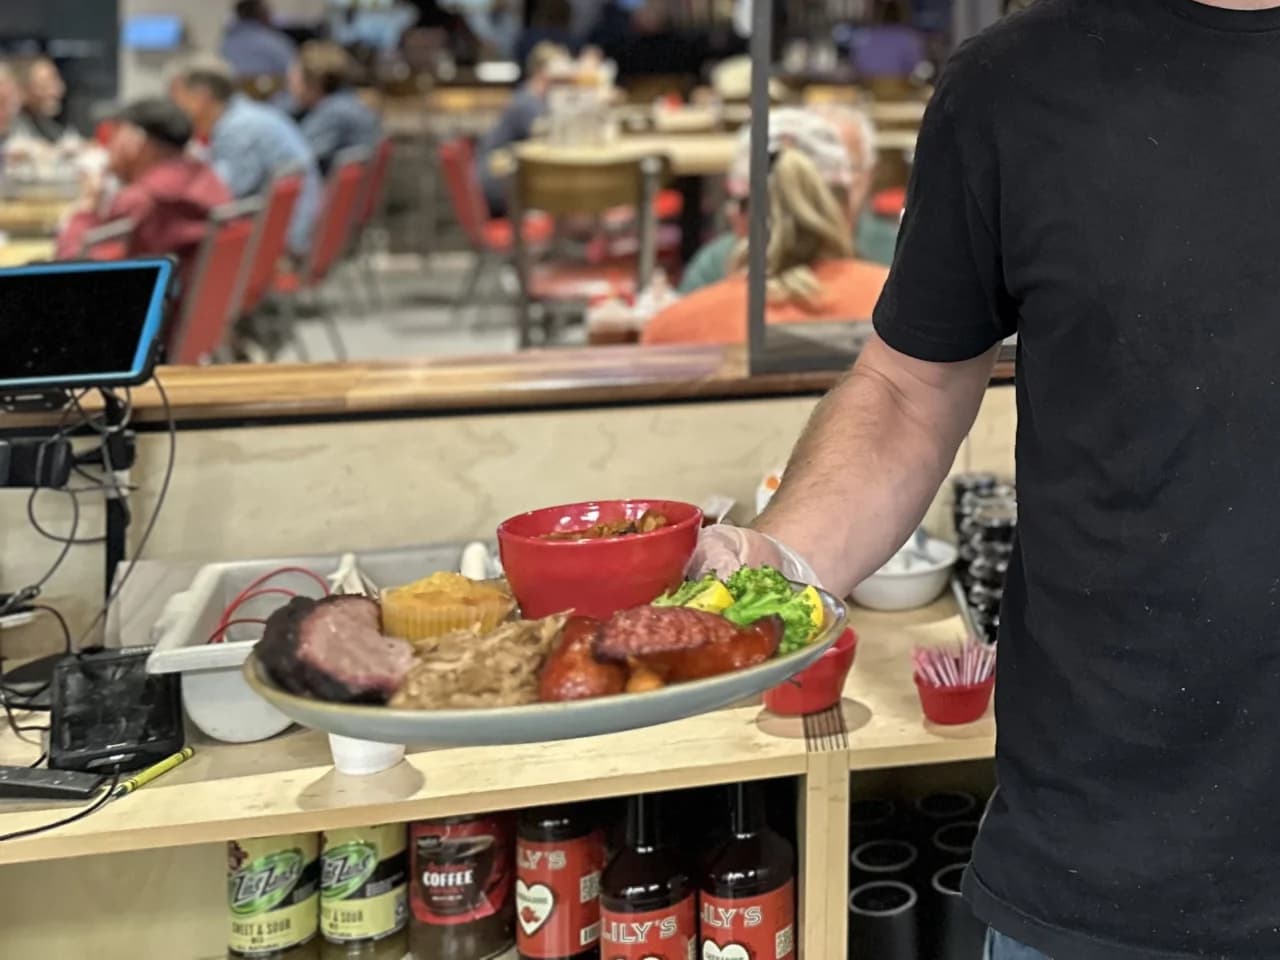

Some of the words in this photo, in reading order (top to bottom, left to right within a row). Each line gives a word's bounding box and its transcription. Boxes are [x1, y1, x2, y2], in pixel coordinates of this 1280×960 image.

[422, 869, 473, 887] COFFEE
[702, 902, 762, 928] ILY'S
[266, 919, 291, 935] SOUR
